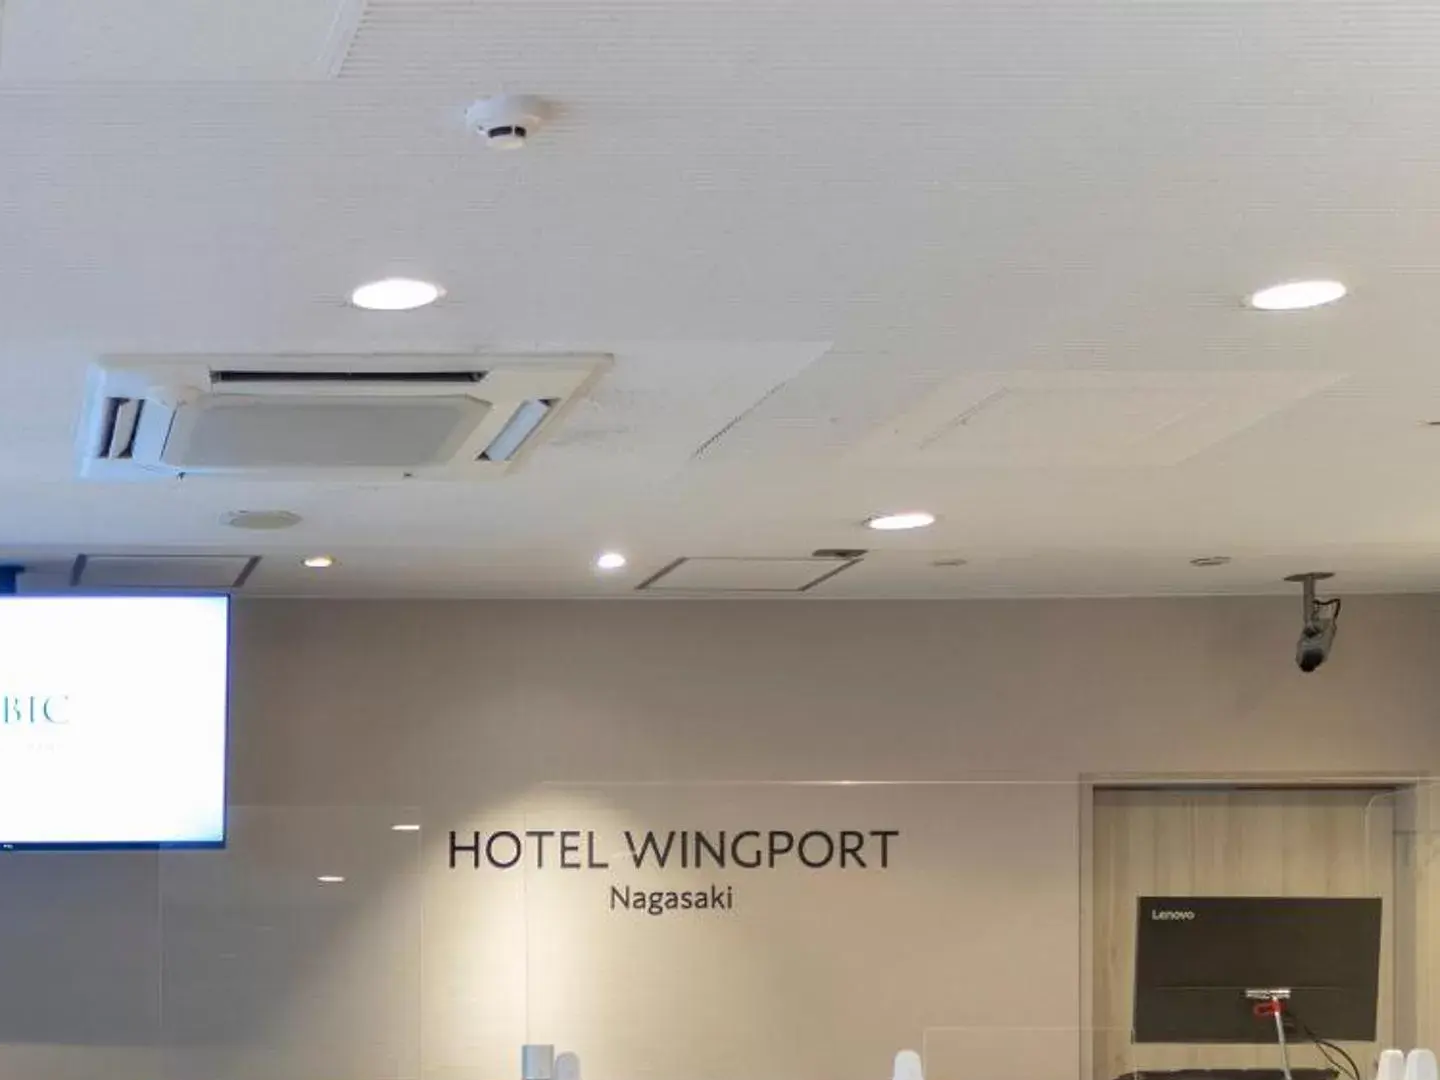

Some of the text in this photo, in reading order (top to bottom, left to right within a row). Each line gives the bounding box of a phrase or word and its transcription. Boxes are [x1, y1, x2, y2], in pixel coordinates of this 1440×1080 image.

[449, 830, 900, 868] HOTEL WINGPORT
[610, 885, 734, 914] Nagasaki
[1151, 909, 1195, 921] Lenovo
